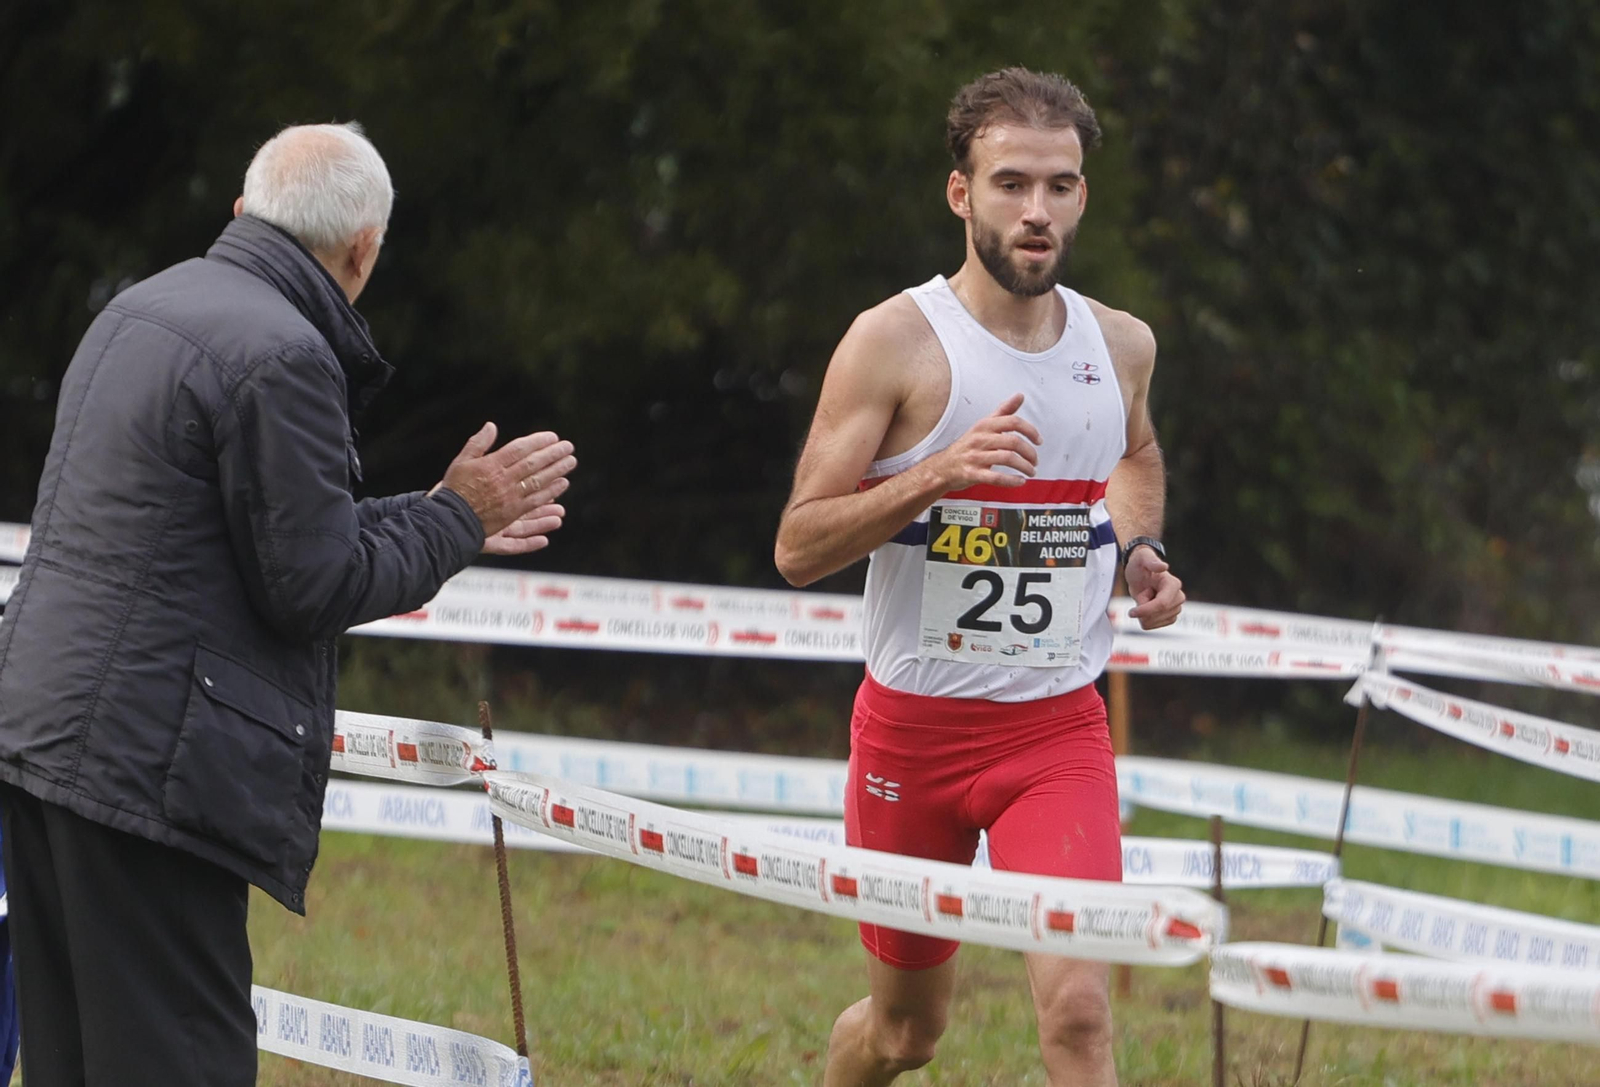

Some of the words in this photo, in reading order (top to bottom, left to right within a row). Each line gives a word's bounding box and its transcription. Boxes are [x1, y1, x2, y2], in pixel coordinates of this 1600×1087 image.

[944, 508, 978, 517] CONCELLO
[1028, 514, 1090, 528] MEMORIAL
[1020, 530, 1089, 543] BELARMINO
[1039, 546, 1086, 559] ALONSO
[956, 570, 1053, 634] 25
